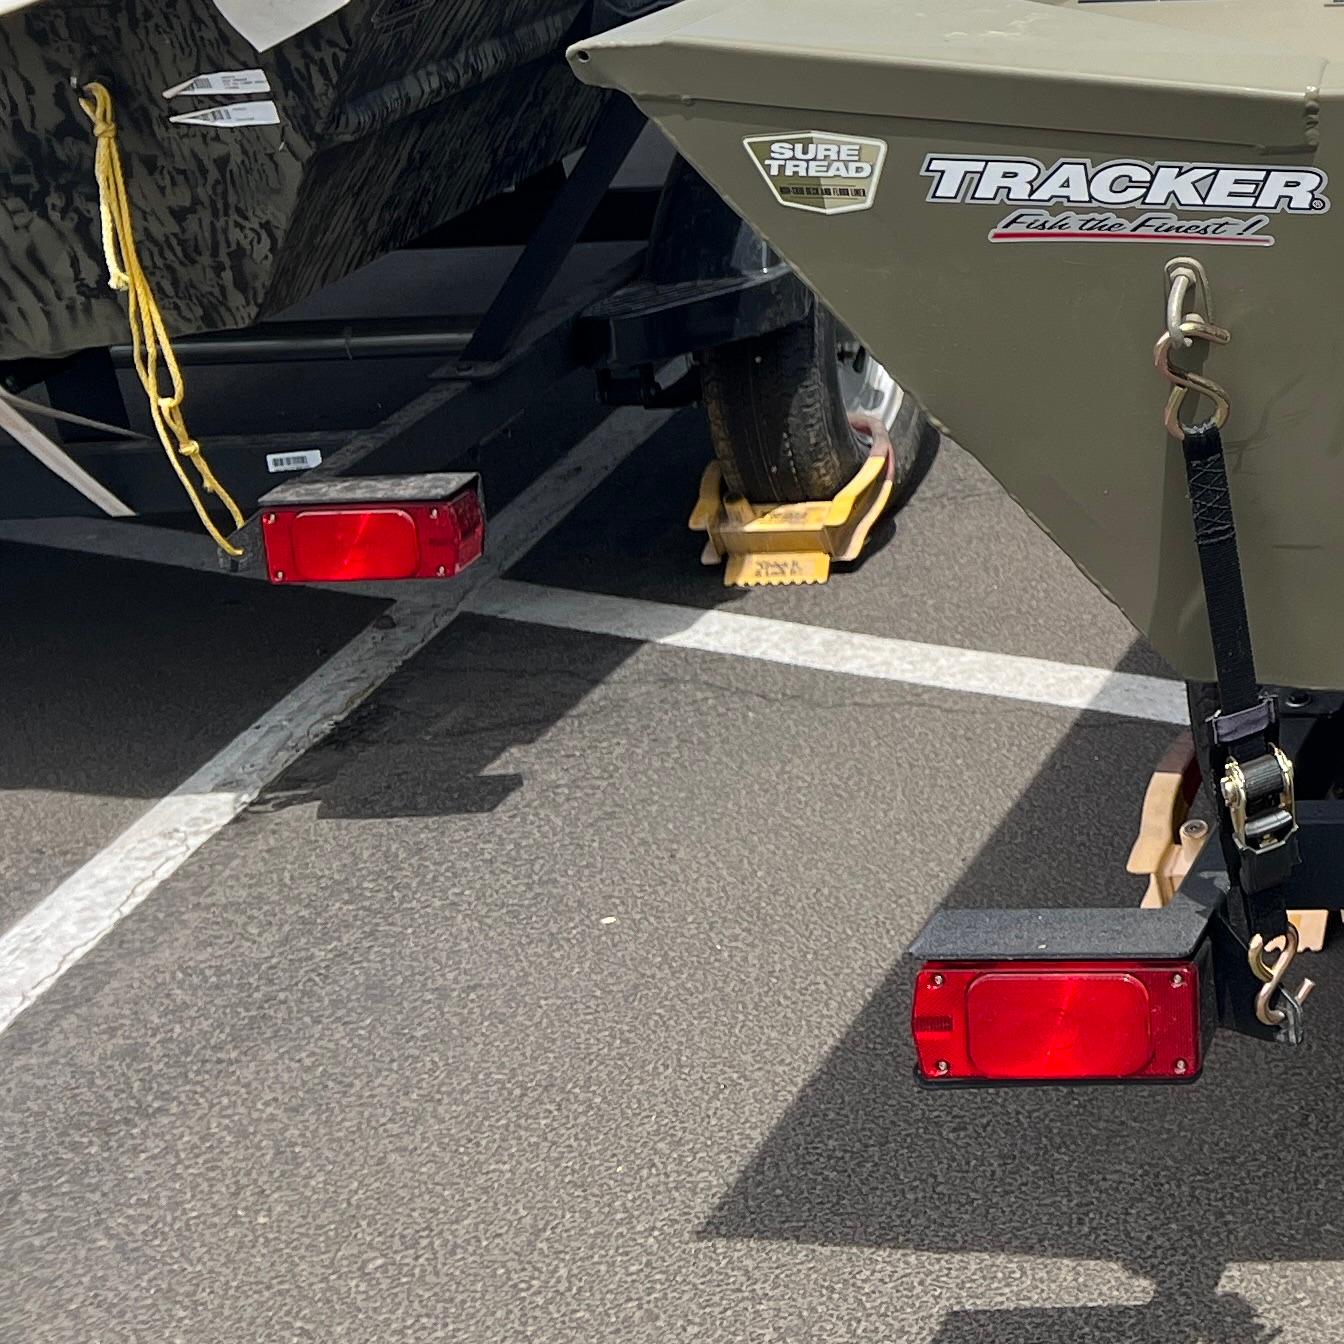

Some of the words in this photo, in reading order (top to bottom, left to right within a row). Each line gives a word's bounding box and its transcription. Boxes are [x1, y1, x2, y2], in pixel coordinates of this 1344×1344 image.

[771, 142, 860, 160] SURE
[764, 159, 872, 177] TREAD
[925, 157, 1322, 210] TRACKER
[1002, 213, 1071, 230] Fish
[1078, 215, 1126, 233] the
